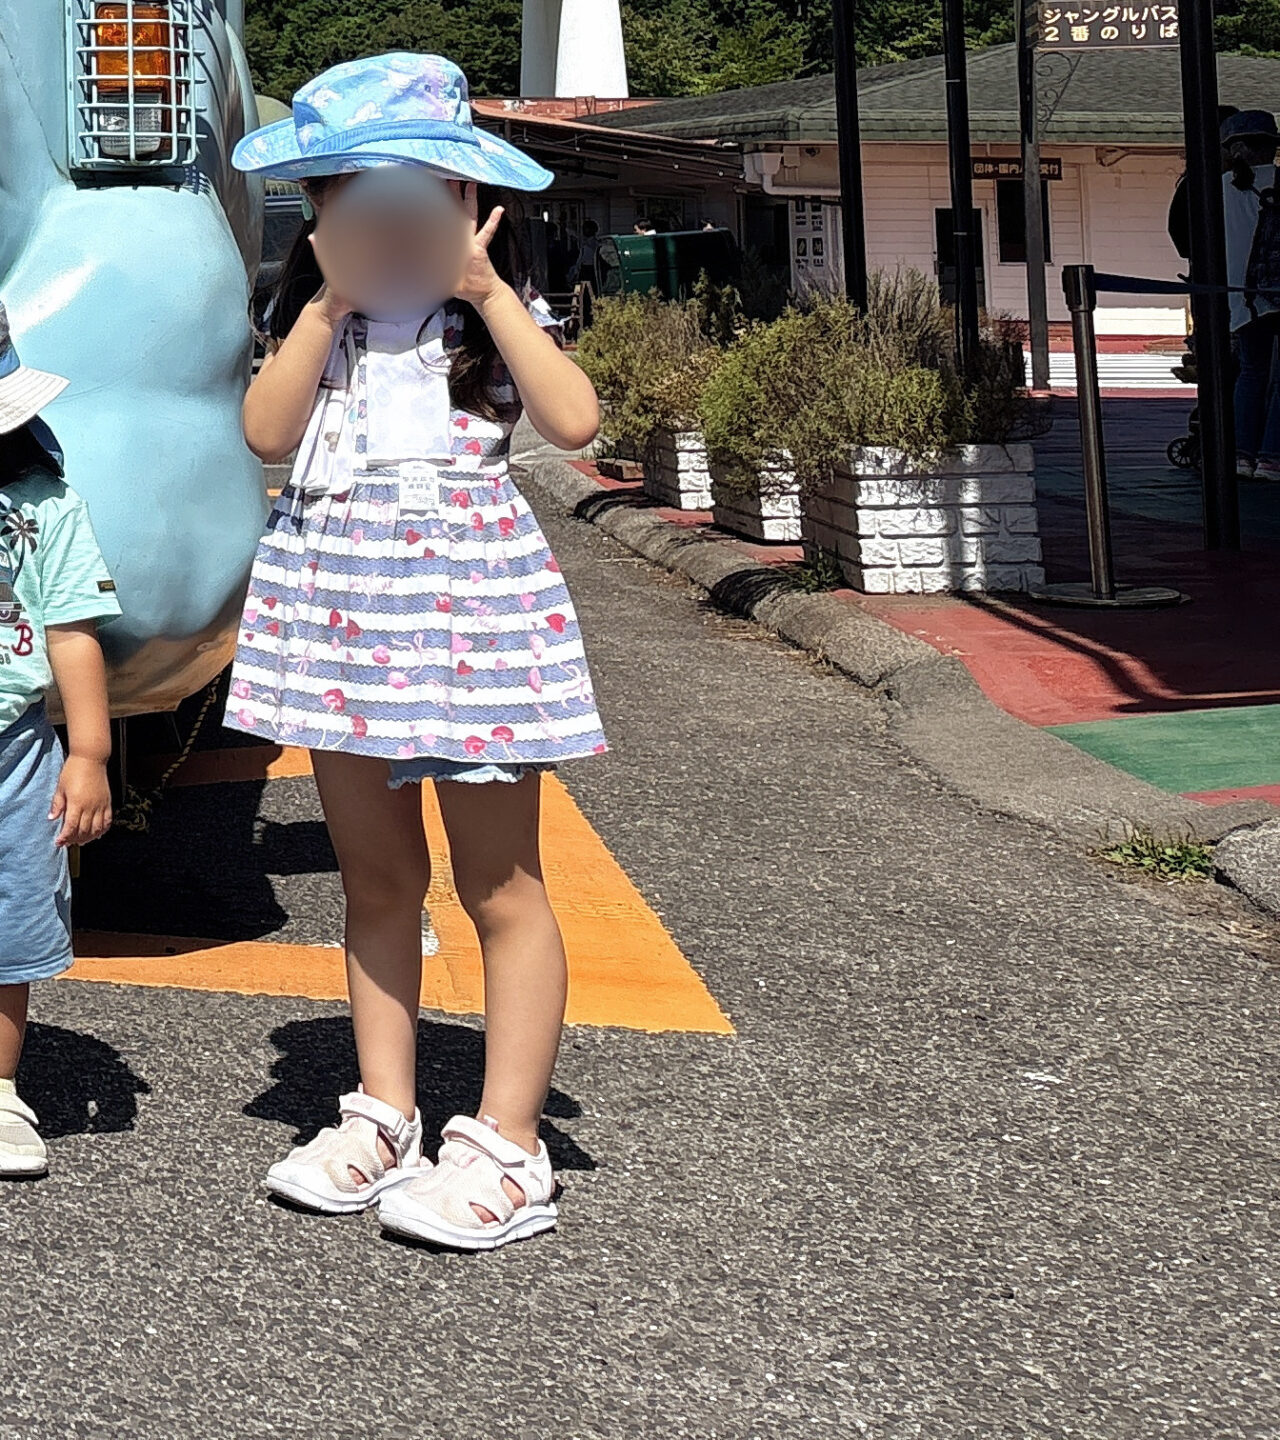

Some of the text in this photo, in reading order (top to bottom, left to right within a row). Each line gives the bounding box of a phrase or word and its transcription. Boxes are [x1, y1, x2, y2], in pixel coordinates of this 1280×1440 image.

[1043, 5, 1179, 24] ジャングルバス
[11, 624, 34, 656] B
